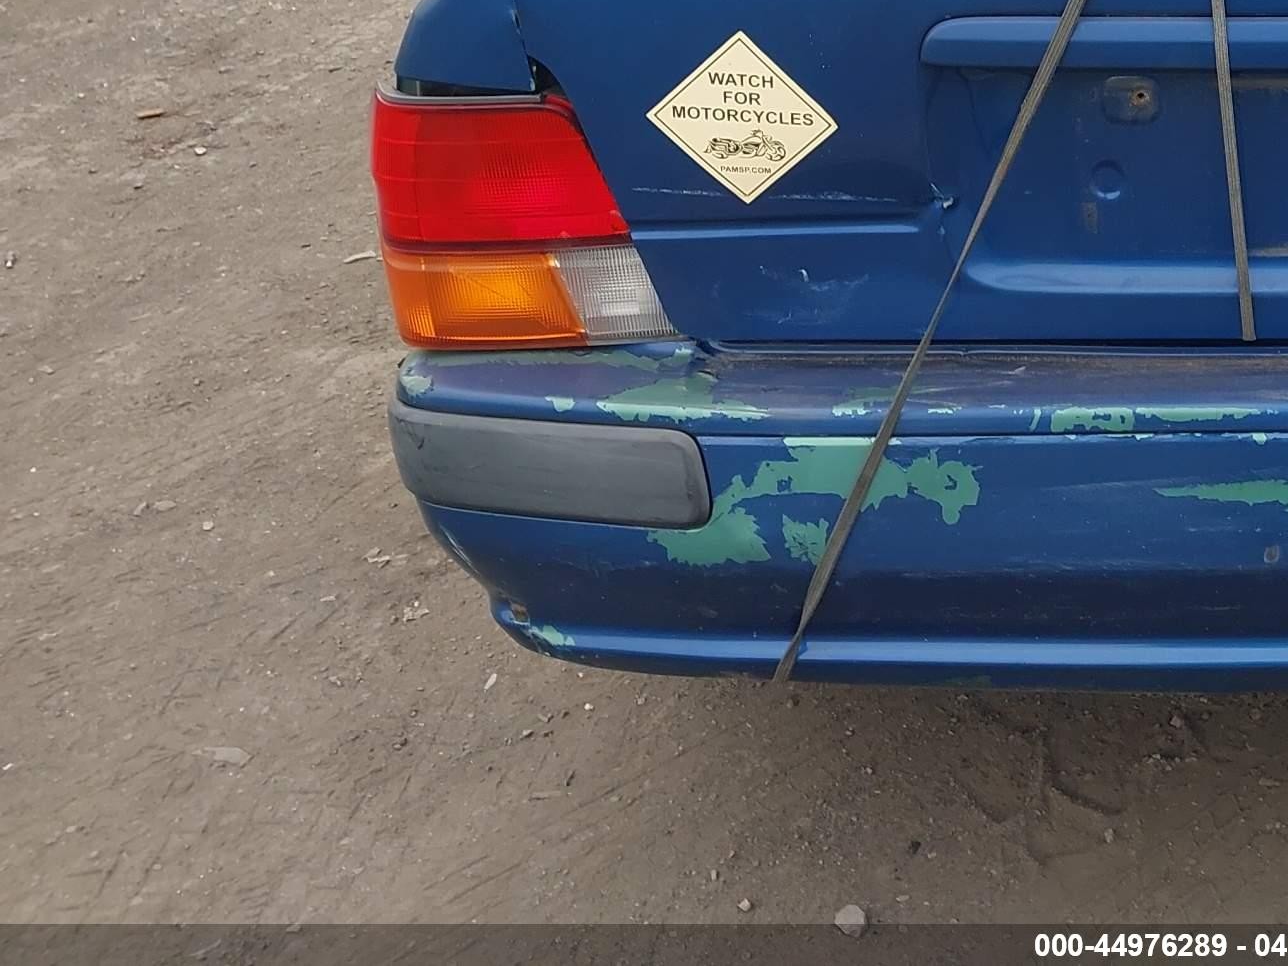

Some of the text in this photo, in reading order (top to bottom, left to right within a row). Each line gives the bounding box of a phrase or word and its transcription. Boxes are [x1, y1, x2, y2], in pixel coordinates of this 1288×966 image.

[707, 71, 774, 89] WATCH
[723, 90, 761, 106] FOR
[671, 105, 814, 127] MOTORCYCLES
[719, 165, 772, 175] PAMSP.COM
